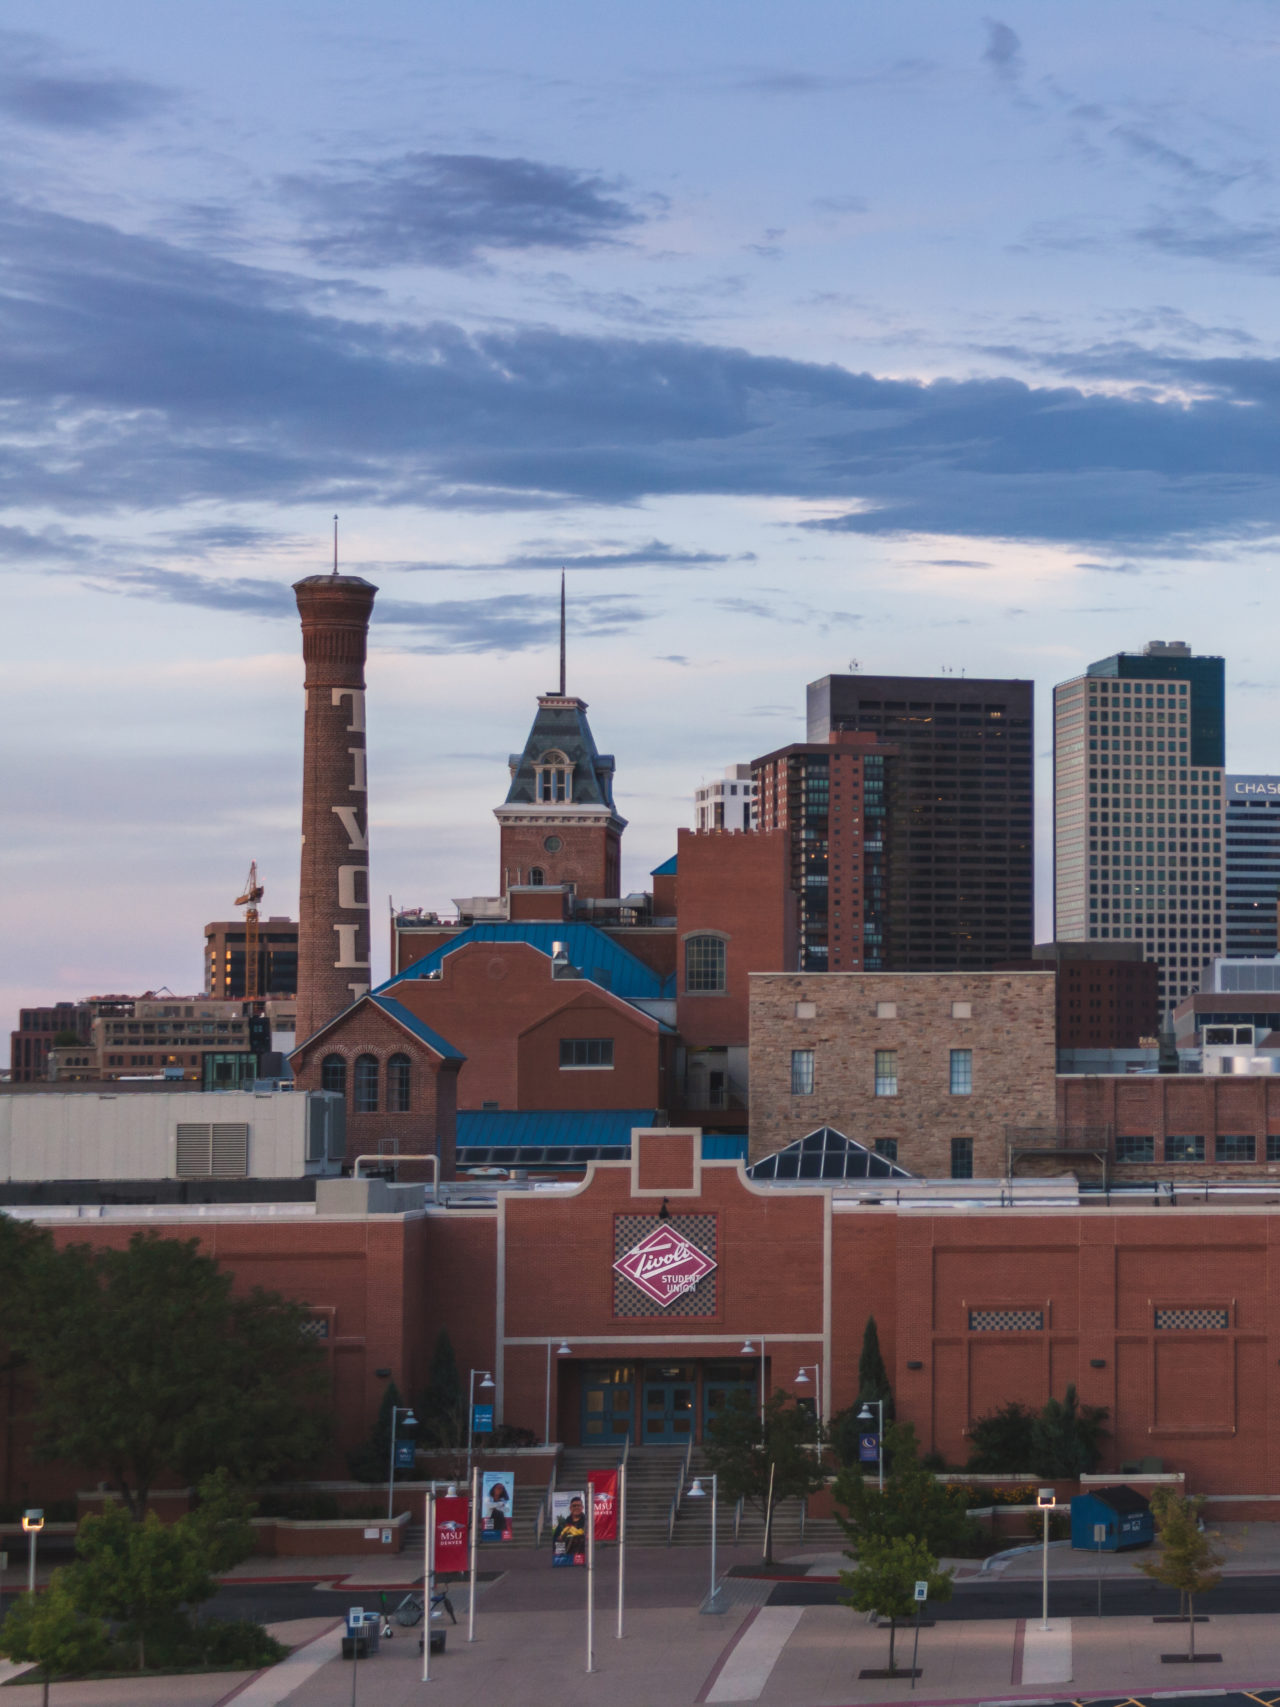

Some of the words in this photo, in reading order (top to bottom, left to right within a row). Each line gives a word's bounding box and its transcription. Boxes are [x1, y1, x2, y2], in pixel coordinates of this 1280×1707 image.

[631, 1242, 693, 1279] Tivoli
[662, 1275, 701, 1283] STUDENT
[667, 1284, 696, 1292] UNION
[441, 1532, 462, 1540] MSU
